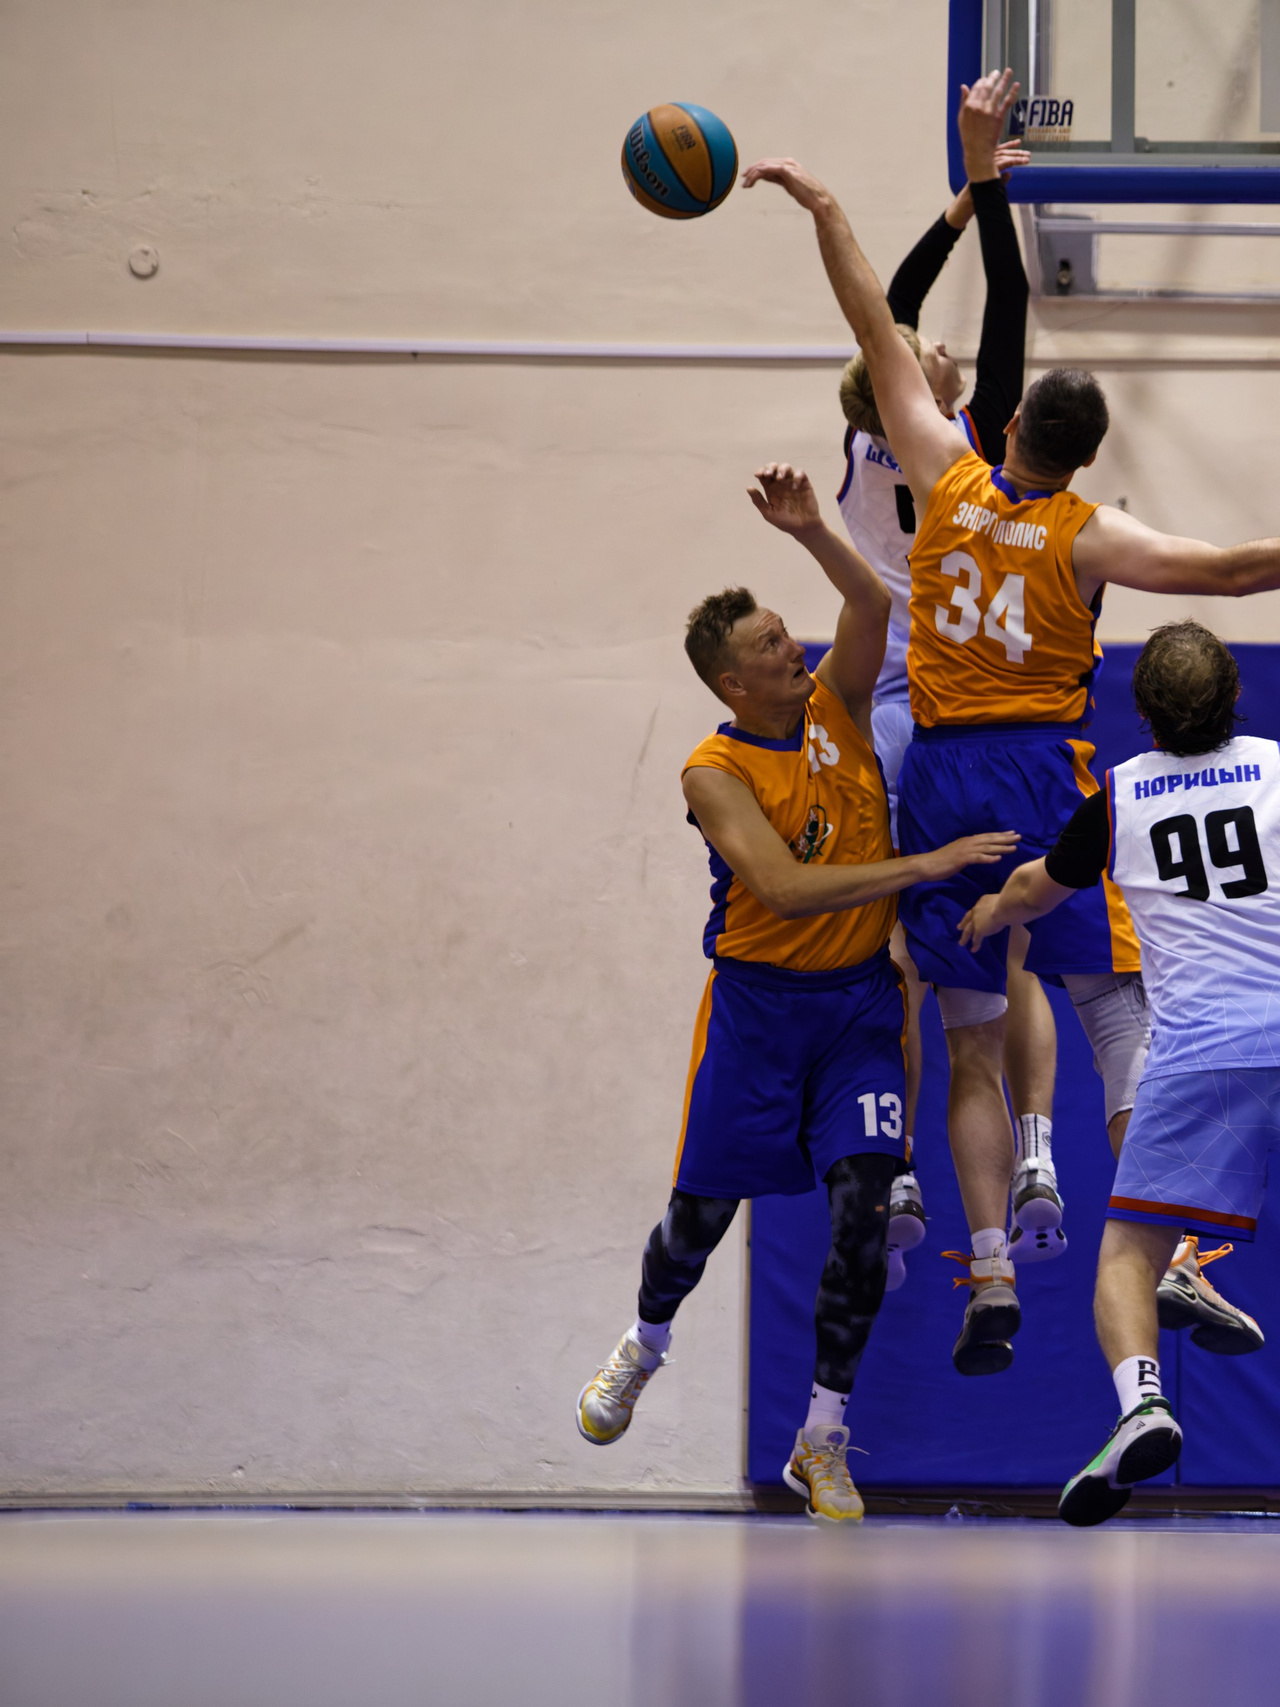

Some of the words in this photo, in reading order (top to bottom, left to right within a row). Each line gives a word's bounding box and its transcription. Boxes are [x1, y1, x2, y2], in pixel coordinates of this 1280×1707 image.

[1028, 98, 1074, 126] FIBA
[629, 121, 670, 198] Wilson
[934, 550, 1033, 665] 34
[1134, 764, 1262, 801] НОРИЦЫН
[1150, 805, 1269, 902] 99
[857, 1092, 903, 1140] 13
